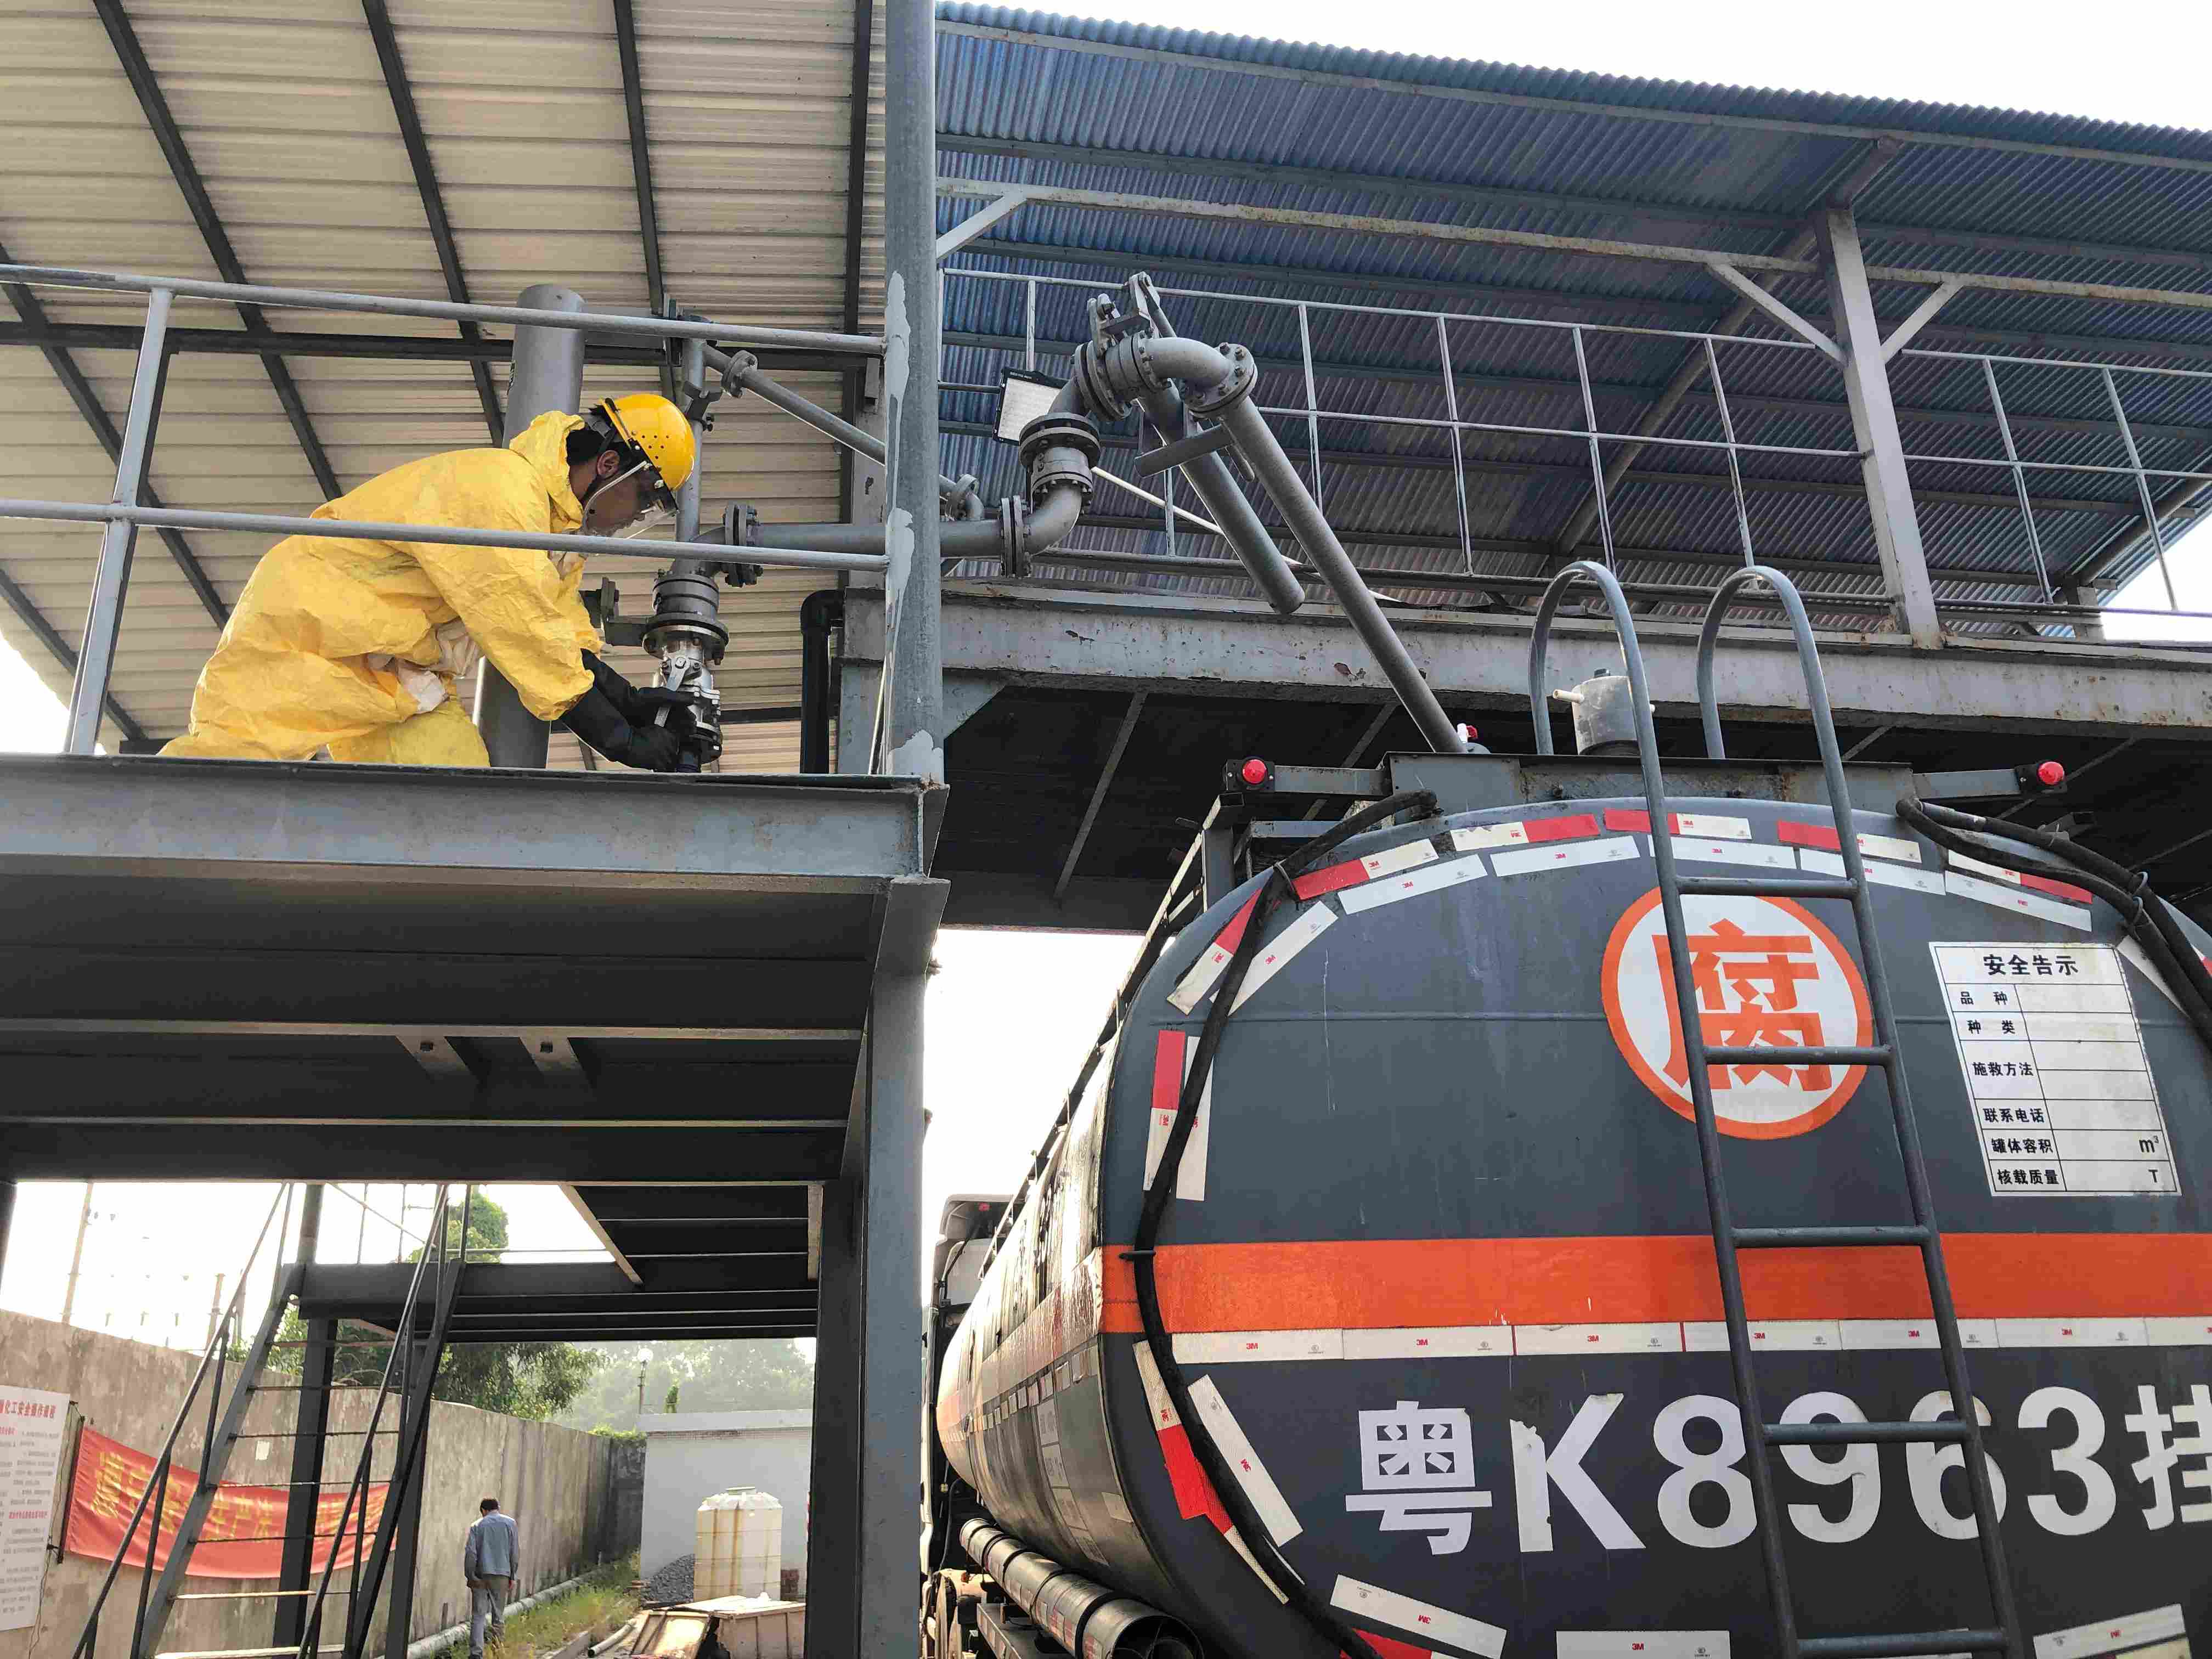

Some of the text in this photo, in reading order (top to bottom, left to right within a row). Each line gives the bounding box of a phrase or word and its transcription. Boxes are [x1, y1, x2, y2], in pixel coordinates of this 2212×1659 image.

[1984, 954, 2079, 975] 安全告示
[1652, 918, 1832, 1091] 腐
[1973, 1062, 2034, 1077] 施救方法
[1983, 1108, 2045, 1124] 联系电话
[1991, 1138, 2053, 1154] 罐体容积
[1997, 1169, 2060, 1185] 核载质量
[2148, 1169, 2159, 1183] T
[1345, 1385, 2212, 1555] 粤K8963挂
